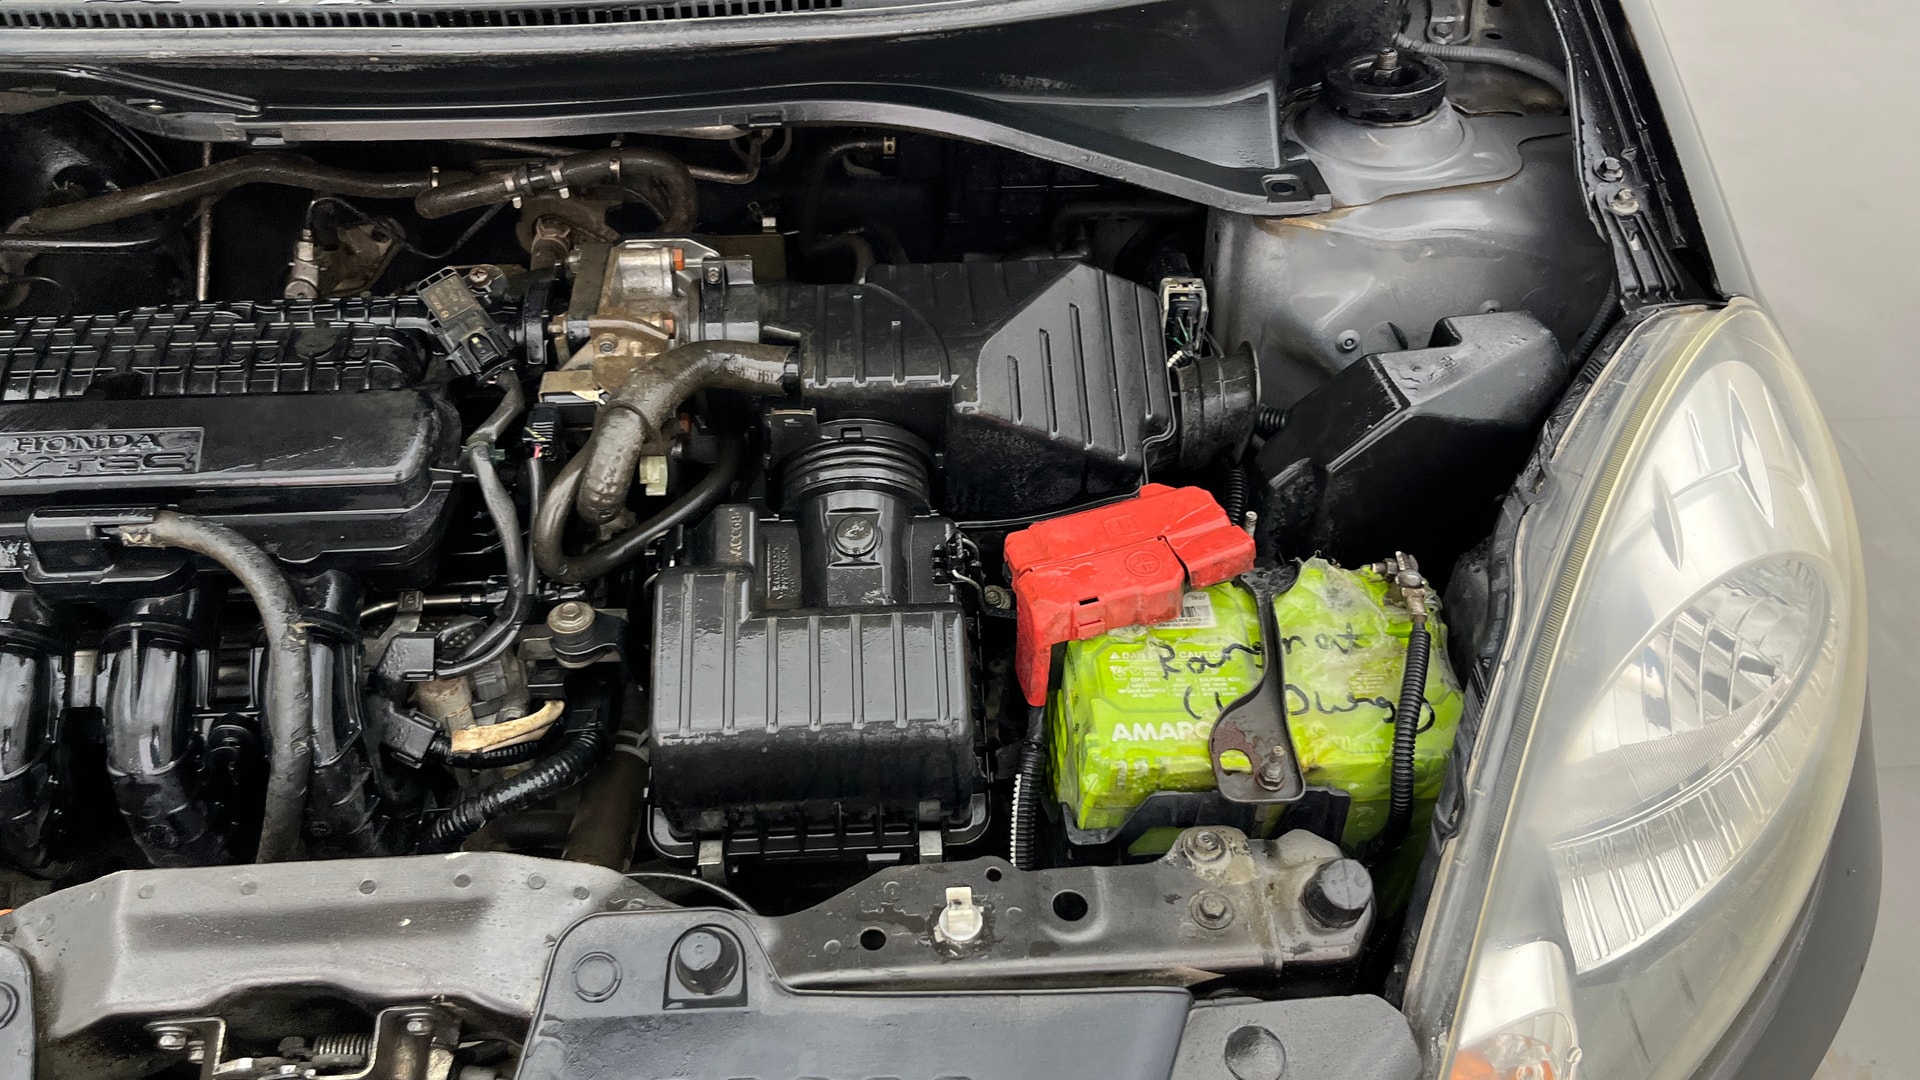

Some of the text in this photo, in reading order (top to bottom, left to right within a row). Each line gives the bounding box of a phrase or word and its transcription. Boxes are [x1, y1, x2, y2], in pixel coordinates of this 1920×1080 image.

[9, 433, 163, 455] HONDA
[1178, 650, 1230, 660] CAUTIO
[1111, 721, 1214, 742] AMARO
